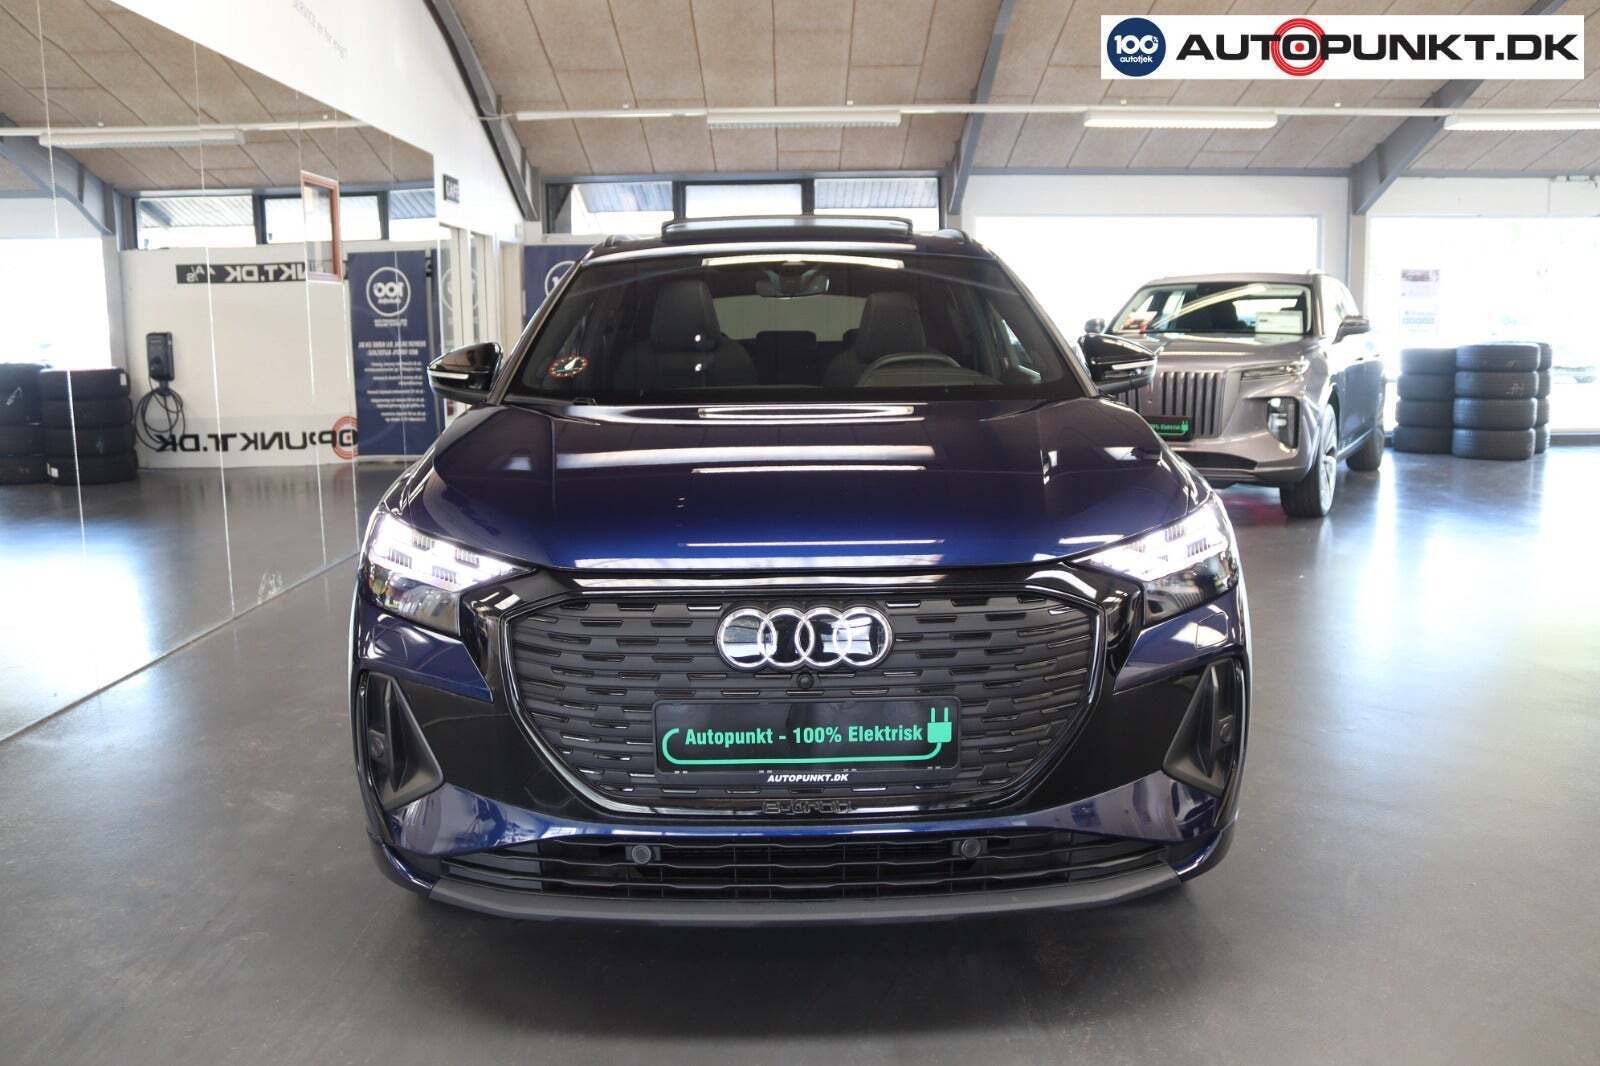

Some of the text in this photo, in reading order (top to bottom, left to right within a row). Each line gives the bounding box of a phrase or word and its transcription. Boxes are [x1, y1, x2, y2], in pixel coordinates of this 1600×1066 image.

[685, 726, 773, 748] Autopunkt
[793, 726, 842, 744] 100%
[848, 724, 922, 743] Elektrisk
[767, 772, 849, 784] AUTOPUNKT.DK
